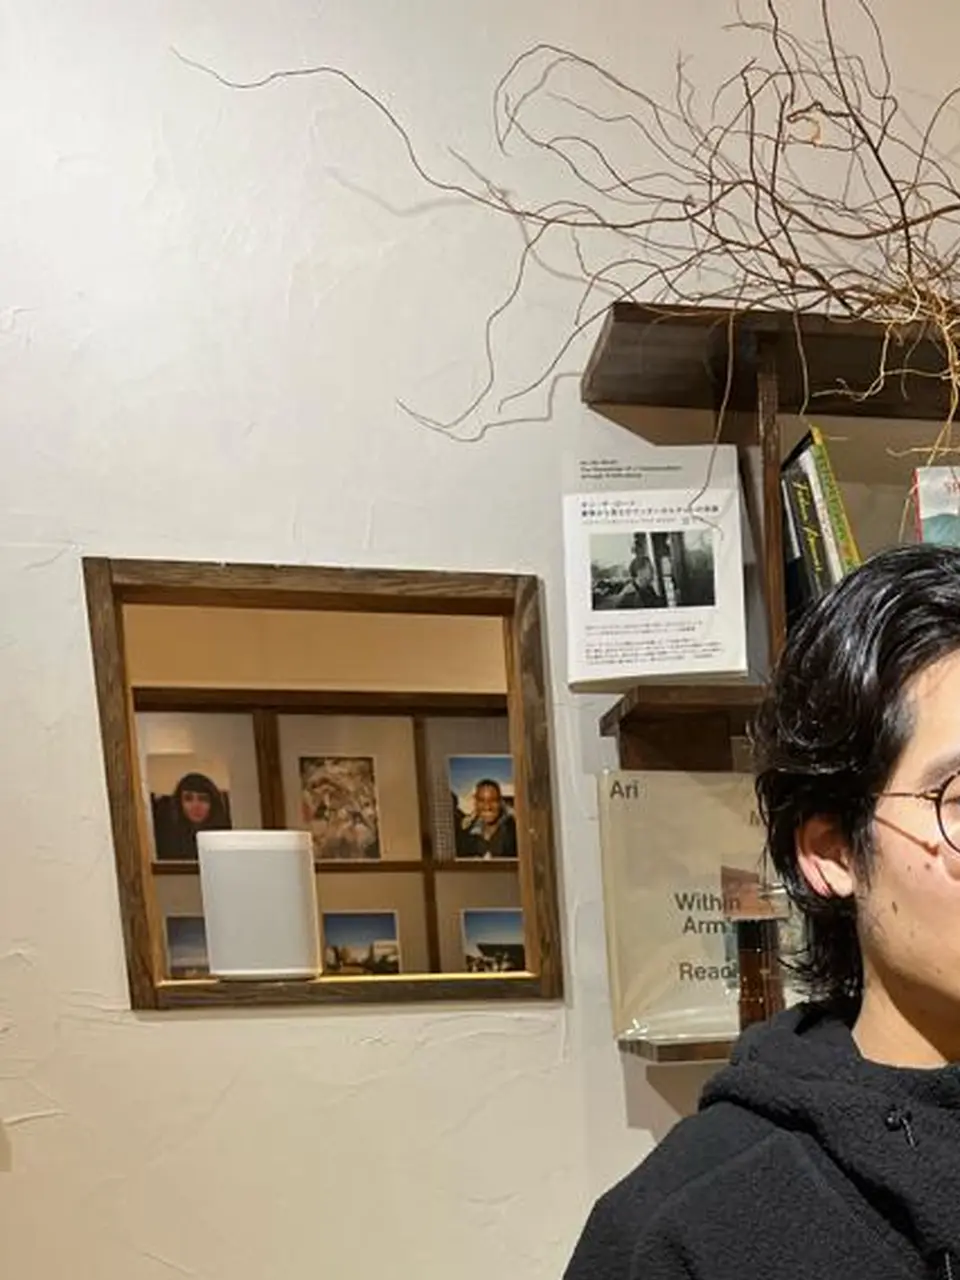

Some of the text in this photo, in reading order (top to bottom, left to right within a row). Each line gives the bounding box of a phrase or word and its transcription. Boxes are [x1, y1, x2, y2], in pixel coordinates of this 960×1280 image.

[610, 780, 639, 800] Ari
[674, 892, 741, 912] Within
[682, 915, 738, 934] Arm'
